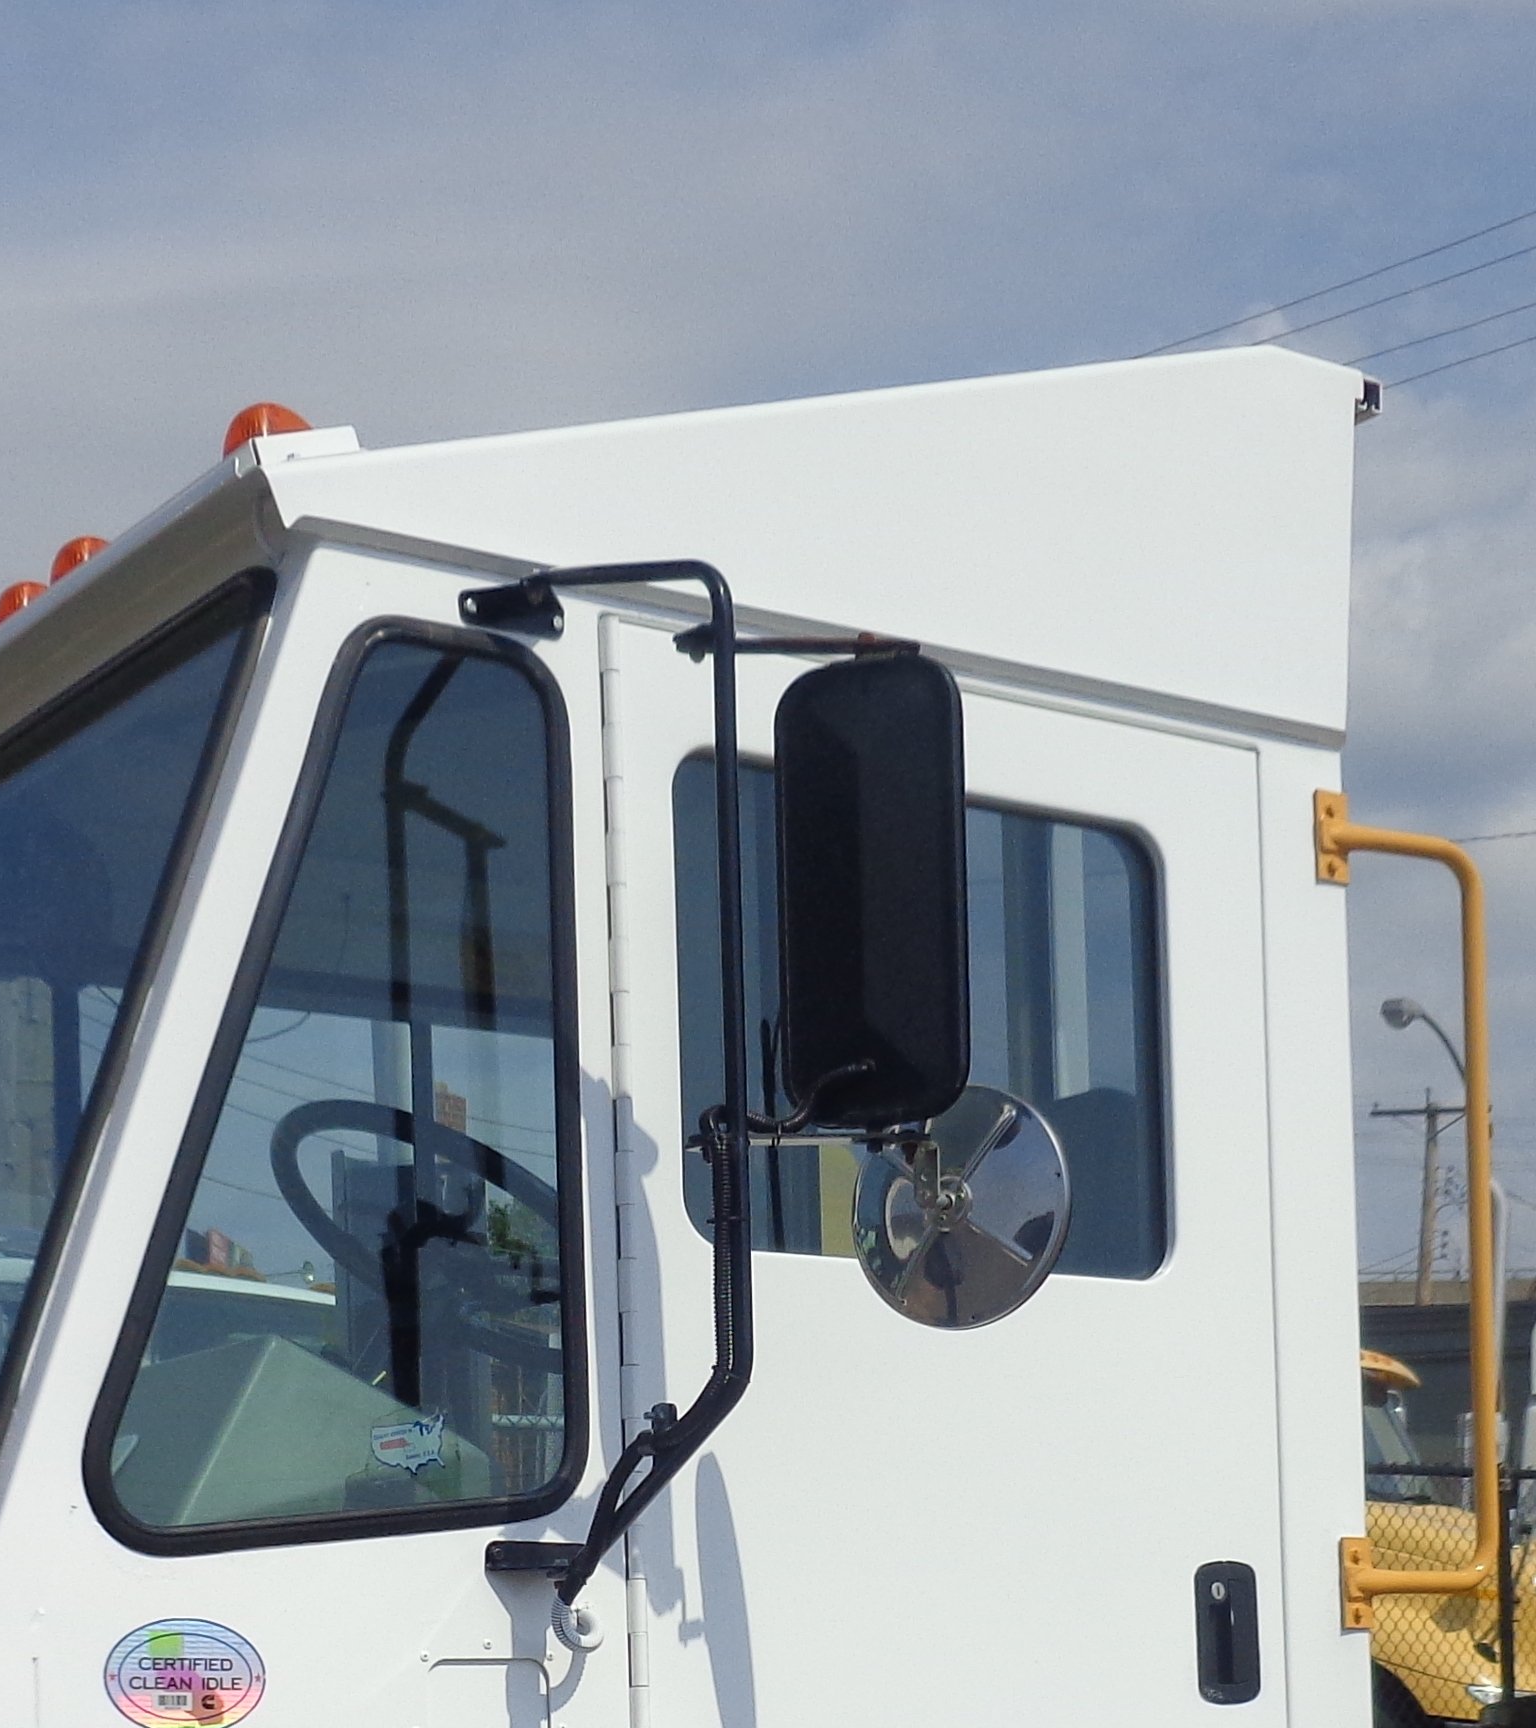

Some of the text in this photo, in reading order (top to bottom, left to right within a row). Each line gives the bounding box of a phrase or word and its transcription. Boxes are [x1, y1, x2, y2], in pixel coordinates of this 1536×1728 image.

[139, 1657, 233, 1671] CERTIFIED
[129, 1676, 243, 1690] CLEAN IDLE
